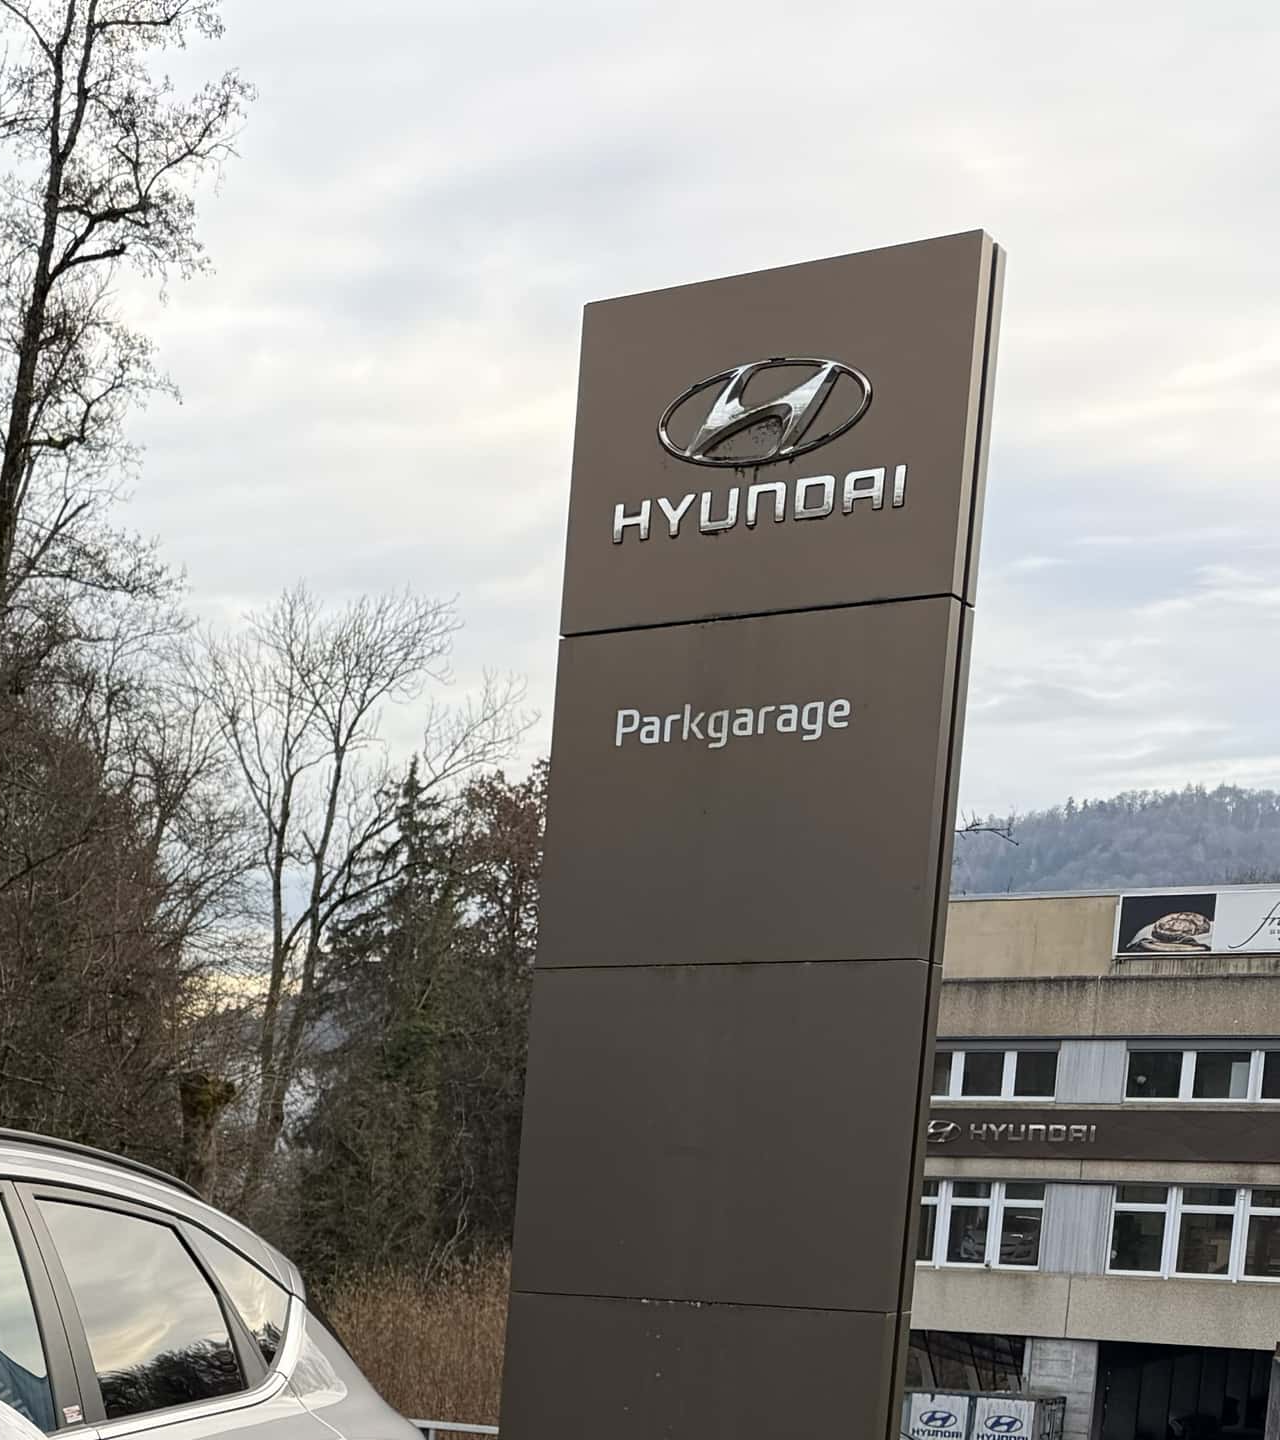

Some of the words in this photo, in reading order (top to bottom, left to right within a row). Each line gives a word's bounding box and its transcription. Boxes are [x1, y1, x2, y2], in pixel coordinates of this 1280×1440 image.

[612, 464, 907, 543] HYUNDAI
[615, 698, 852, 749] Parkgarage
[969, 1123, 1096, 1143] HYUNDAI
[911, 1427, 962, 1439] HYUNDAI
